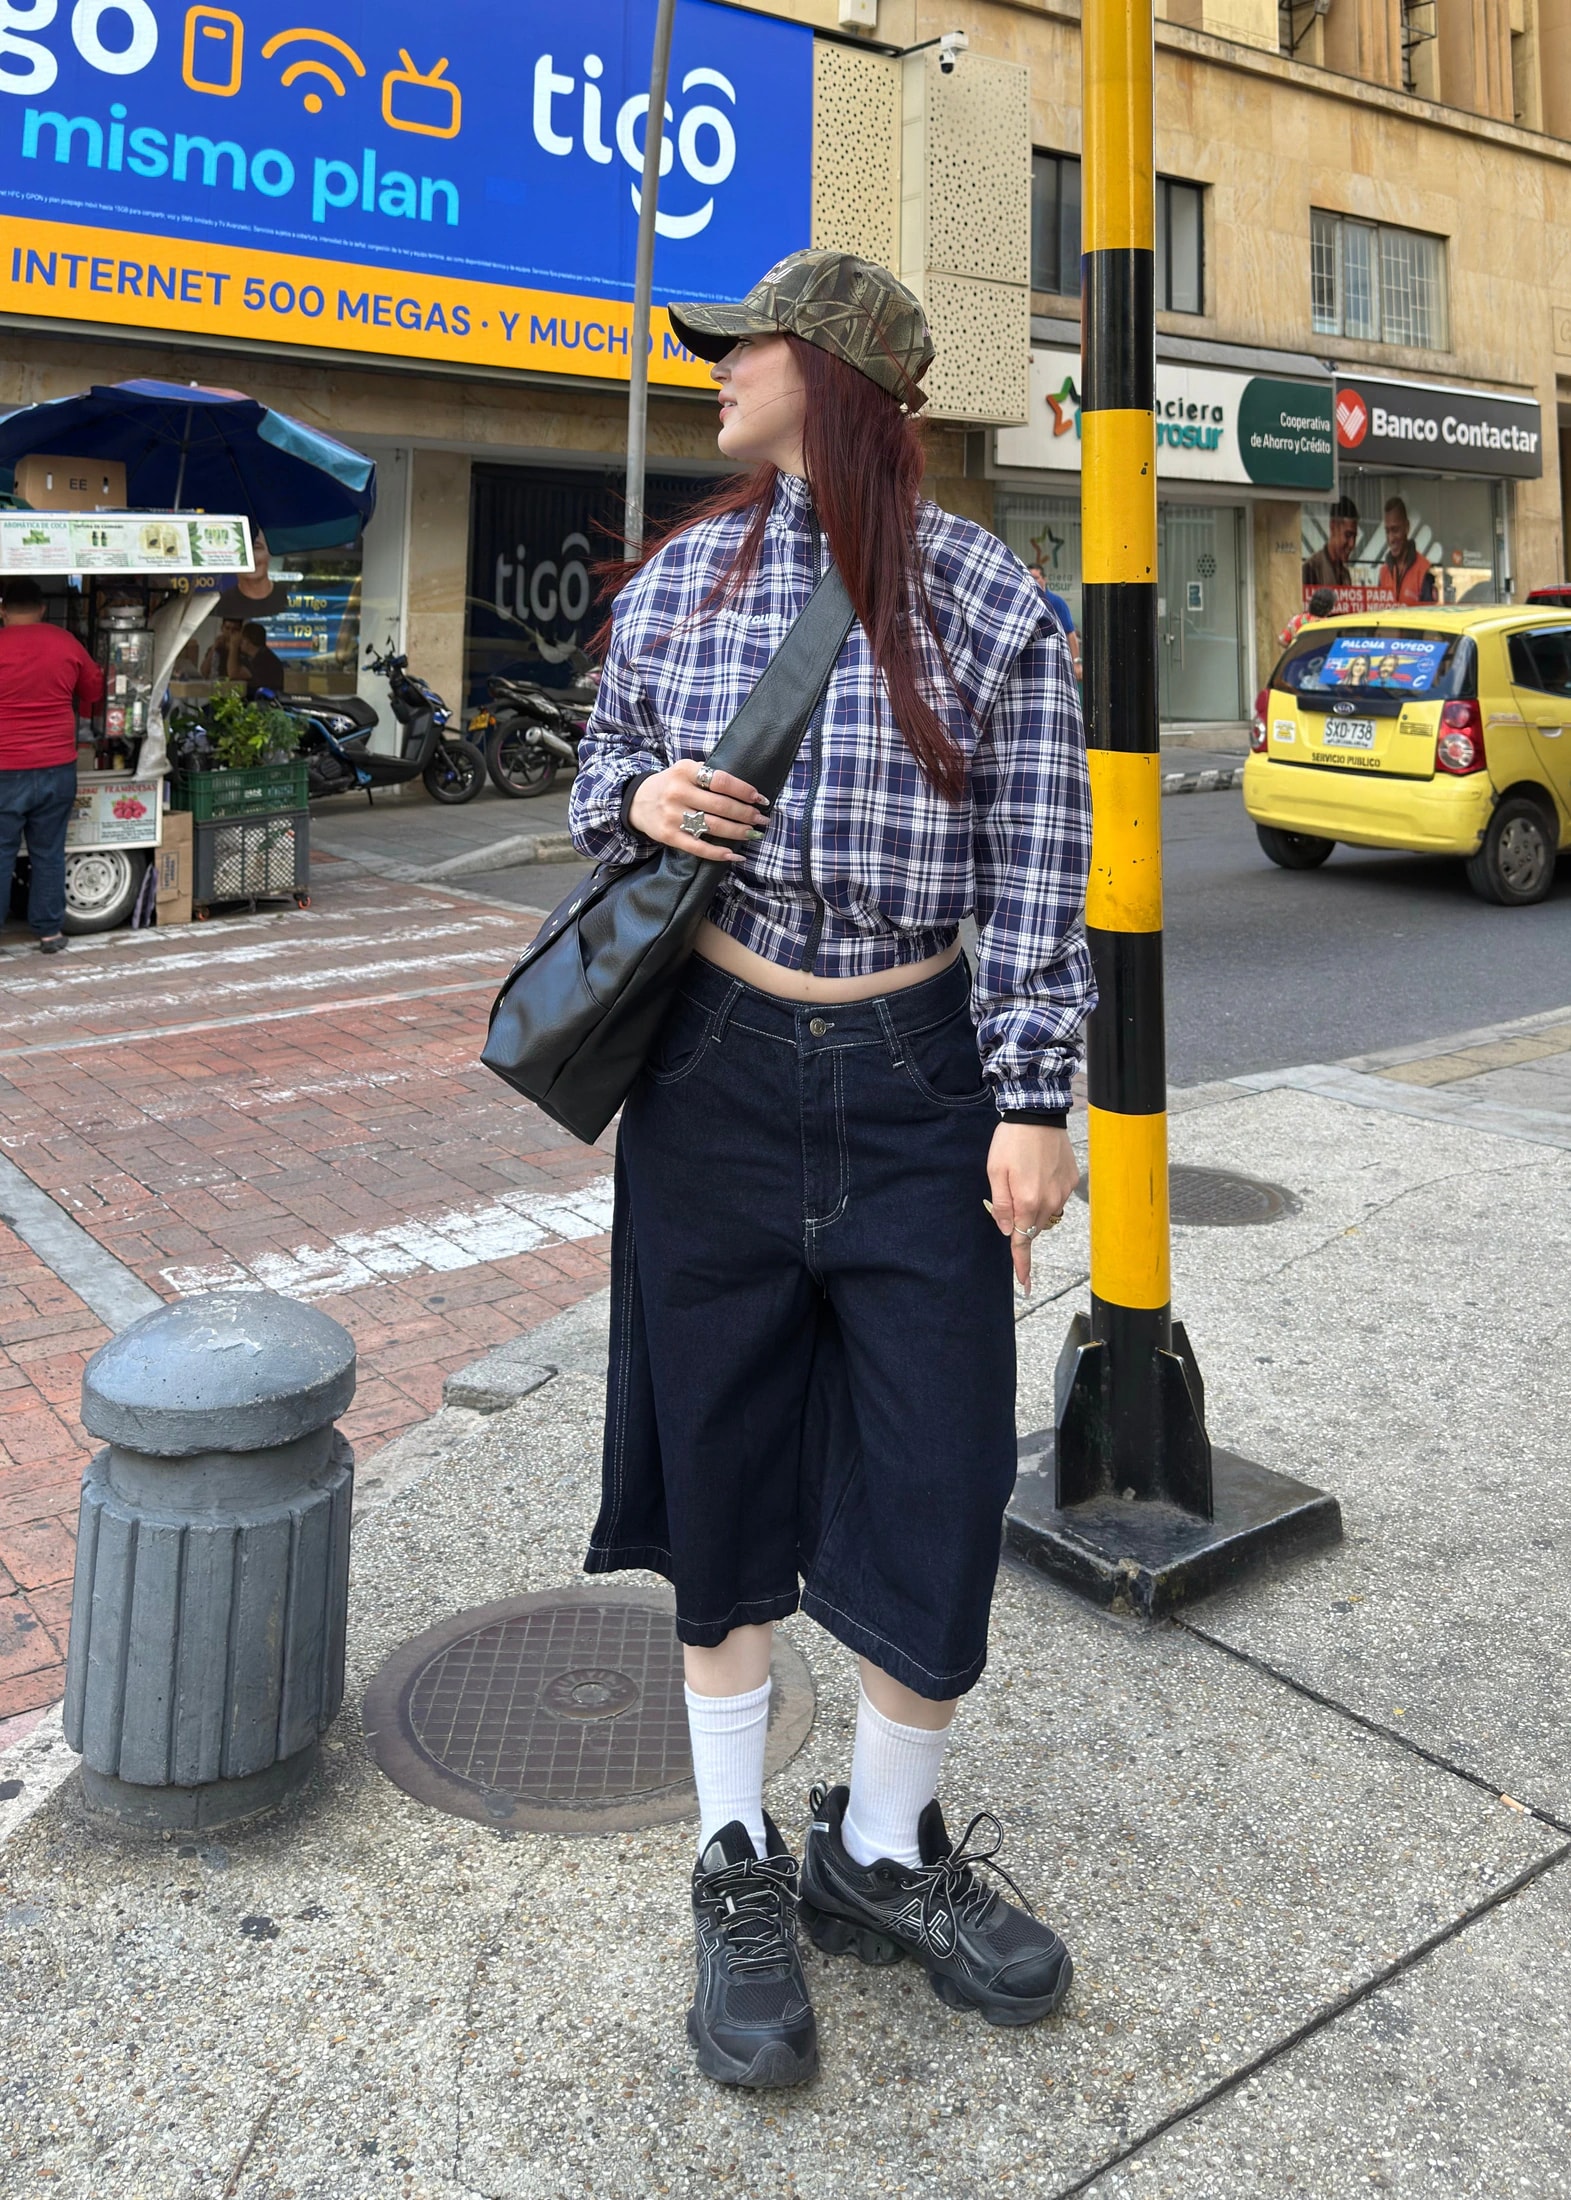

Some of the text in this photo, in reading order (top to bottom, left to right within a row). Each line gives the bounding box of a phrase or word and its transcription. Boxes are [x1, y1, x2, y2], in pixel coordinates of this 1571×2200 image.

[22, 103, 460, 226] mismo plan
[11, 247, 231, 306] INTERNET
[243, 277, 326, 318] 500
[337, 289, 471, 337] MEGAS
[499, 311, 521, 342] Y
[1155, 397, 1224, 423] nciera
[1280, 411, 1331, 432] Cooperativa
[1156, 421, 1225, 451] rosur
[1371, 407, 1538, 453] Banco Contactar
[1250, 432, 1331, 454] de Ahorro y Crédito
[69, 478, 88, 491] EE
[495, 532, 590, 662] tigo
[1366, 590, 1393, 601] PARA
[1341, 640, 1385, 649] PALOMA
[1312, 752, 1381, 768] SERVICIO PUBLICO
